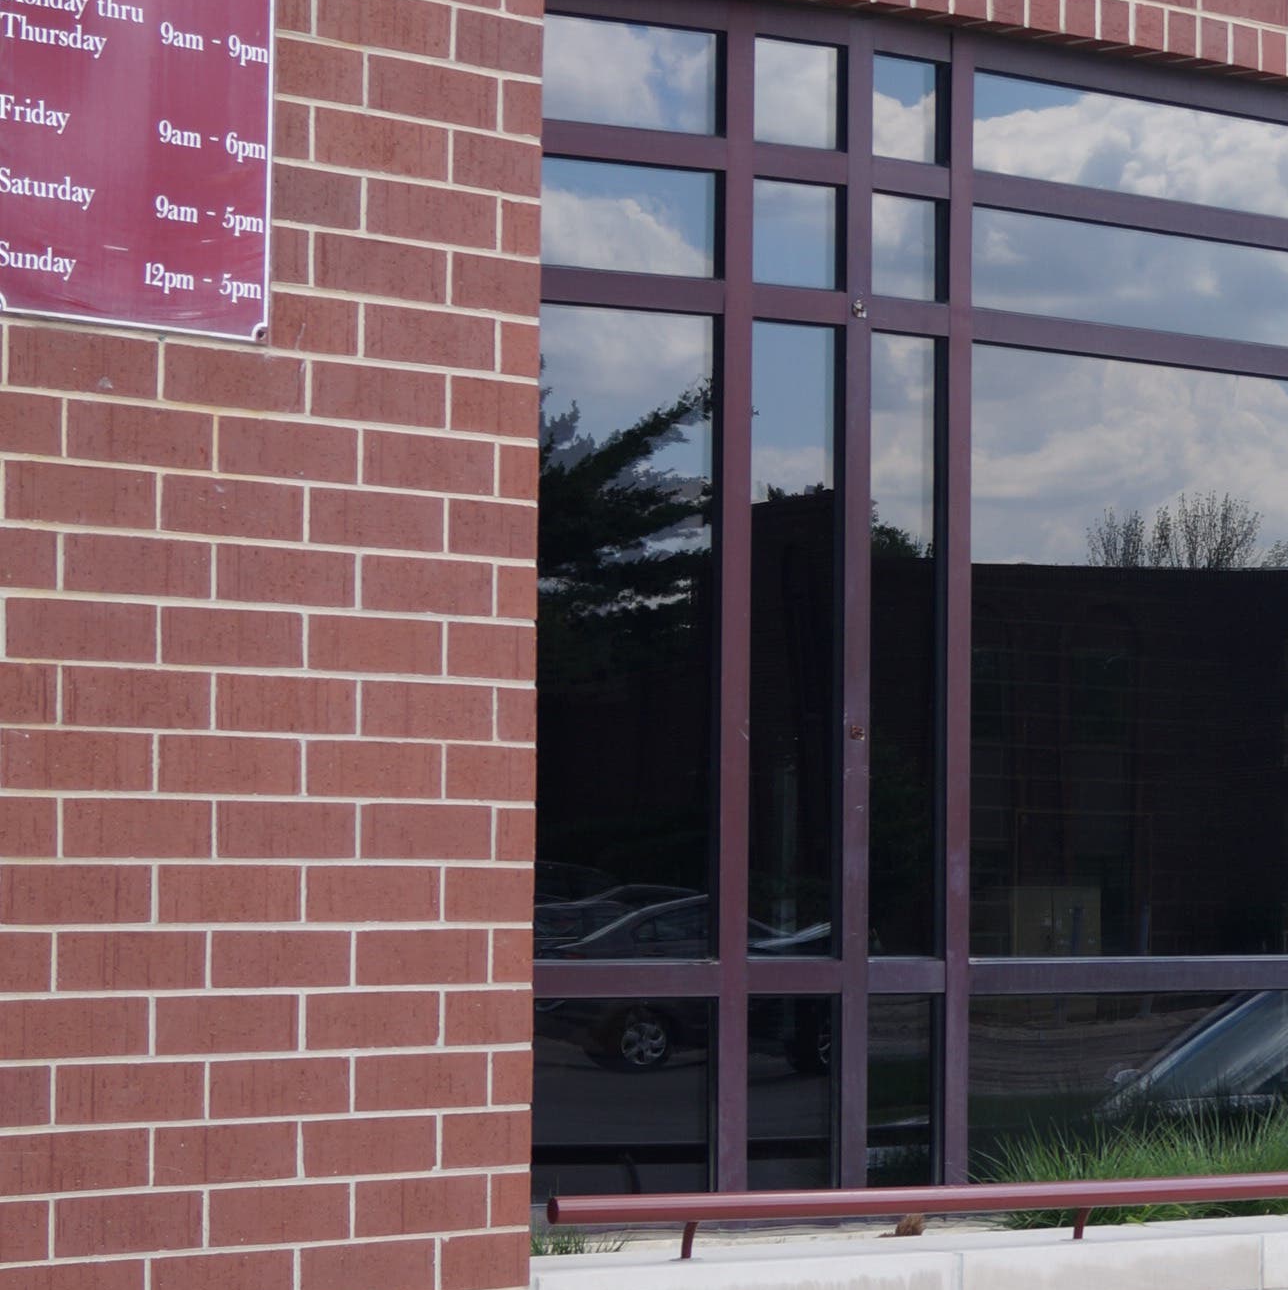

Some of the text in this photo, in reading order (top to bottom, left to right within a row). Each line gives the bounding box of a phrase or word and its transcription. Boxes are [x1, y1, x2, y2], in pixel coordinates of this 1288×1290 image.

[0, 11, 107, 59] Thursday
[160, 21, 204, 51] 9am
[228, 35, 268, 66] 9pm
[0, 93, 71, 134] Friday
[158, 120, 201, 148] 9am
[225, 132, 266, 162] 6pm
[0, 167, 95, 211] Saturday
[155, 195, 198, 223] 9am
[222, 207, 264, 237] 5pm
[0, 240, 76, 281] Sunday
[144, 262, 194, 294] 12pm
[219, 274, 262, 303] 5pm
